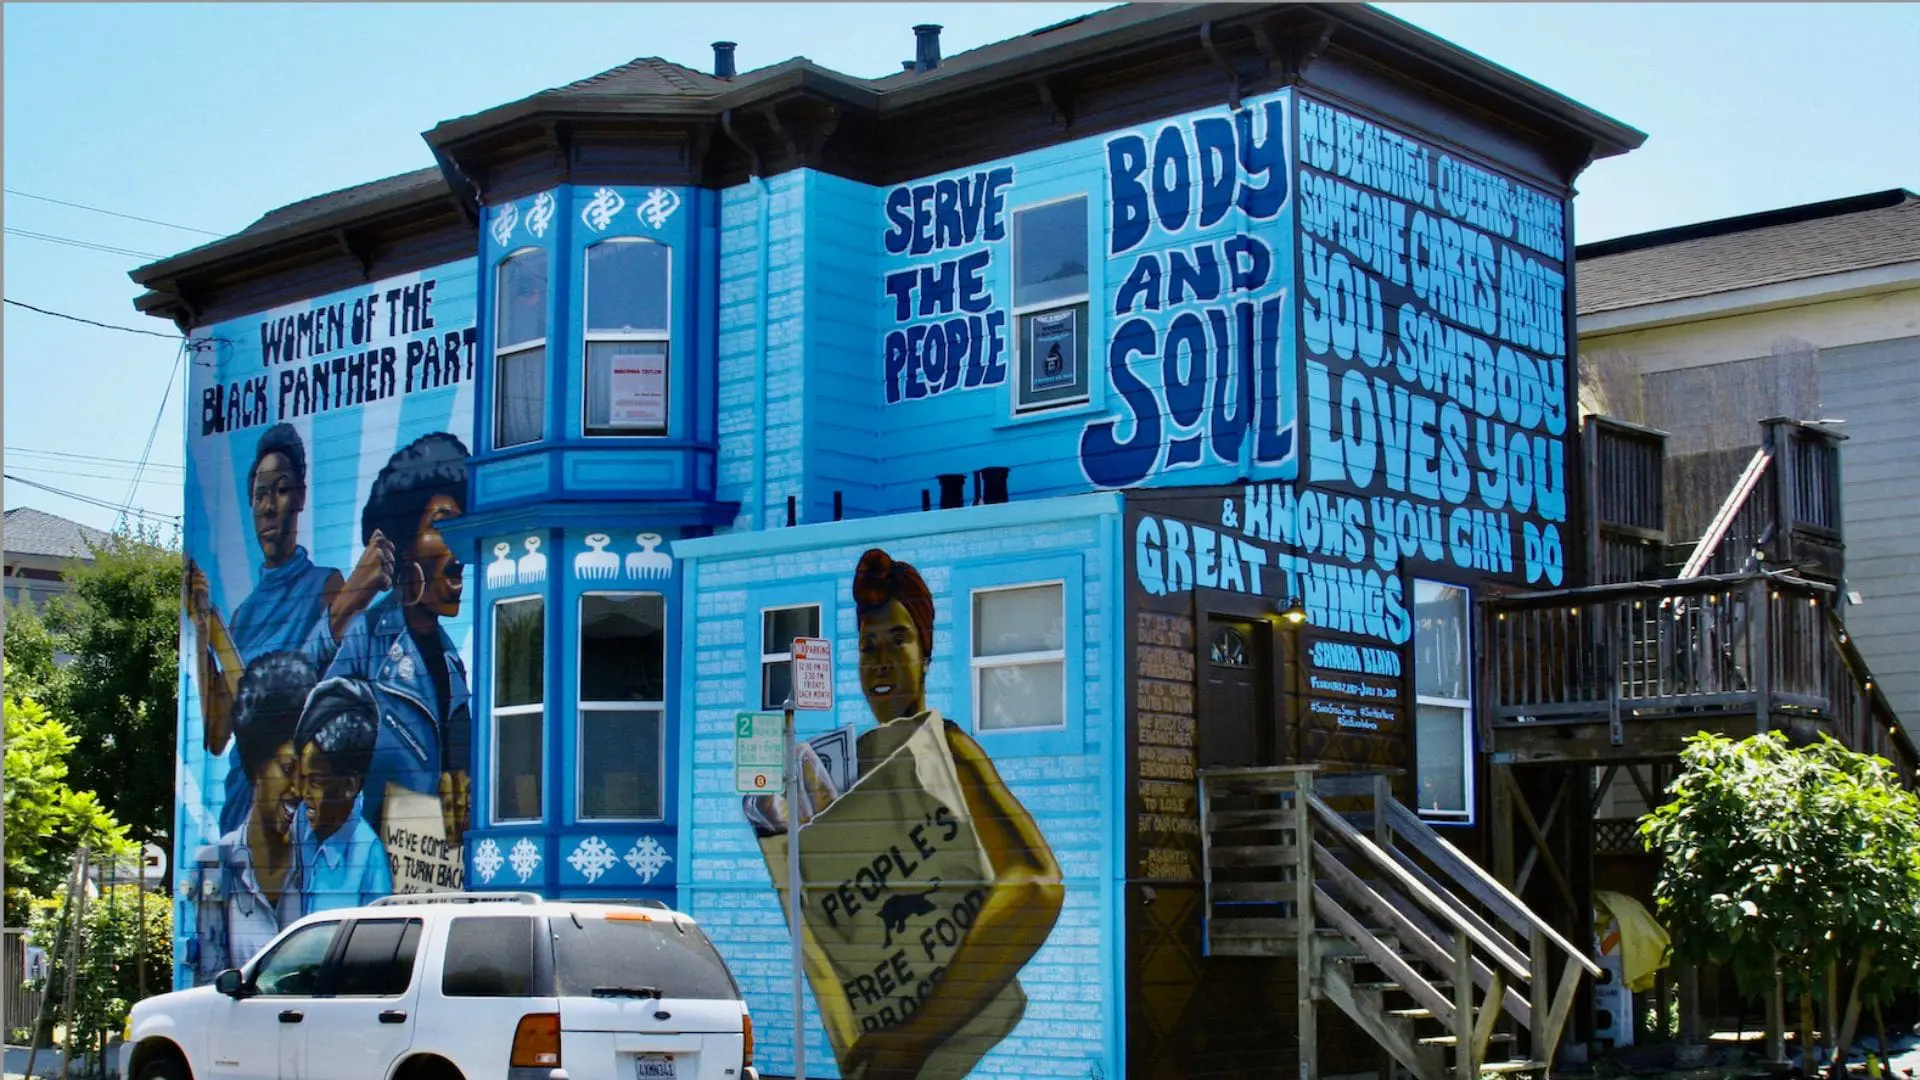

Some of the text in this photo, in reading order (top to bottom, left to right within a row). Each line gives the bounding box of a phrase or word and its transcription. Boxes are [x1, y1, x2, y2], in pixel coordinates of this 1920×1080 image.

[885, 166, 1013, 255] SERVE
[1106, 98, 1289, 256] BODY
[1300, 98, 1334, 172] MY
[1437, 155, 1513, 238] QUEENS
[1516, 184, 1565, 262] KINGS
[886, 249, 992, 322] THE
[1115, 233, 1270, 316] AND
[1300, 170, 1566, 357] SOMEONE CARES ABOUT
[260, 279, 436, 367] WOMEN OF THE
[884, 311, 1006, 404] PEOPLE
[202, 376, 267, 436] BLACK
[278, 347, 396, 420] PANTHER
[1080, 290, 1296, 488] SOUL
[1396, 302, 1567, 436] SOMEBODY
[1306, 358, 1566, 522] LOVES YOU
[1136, 516, 1268, 597] GREAT
[1279, 552, 1411, 645] THINGS
[1222, 484, 1564, 587] & KNOWS YOU CAN DO
[1361, 647, 1400, 677] BLAND
[739, 716, 750, 736] 2
[387, 825, 418, 853] WE'VE
[421, 834, 450, 861] COME
[404, 856, 435, 884] TURN
[436, 863, 464, 890] BACK
[821, 806, 958, 928] PEOPLE'S
[843, 949, 915, 1011] FREE
